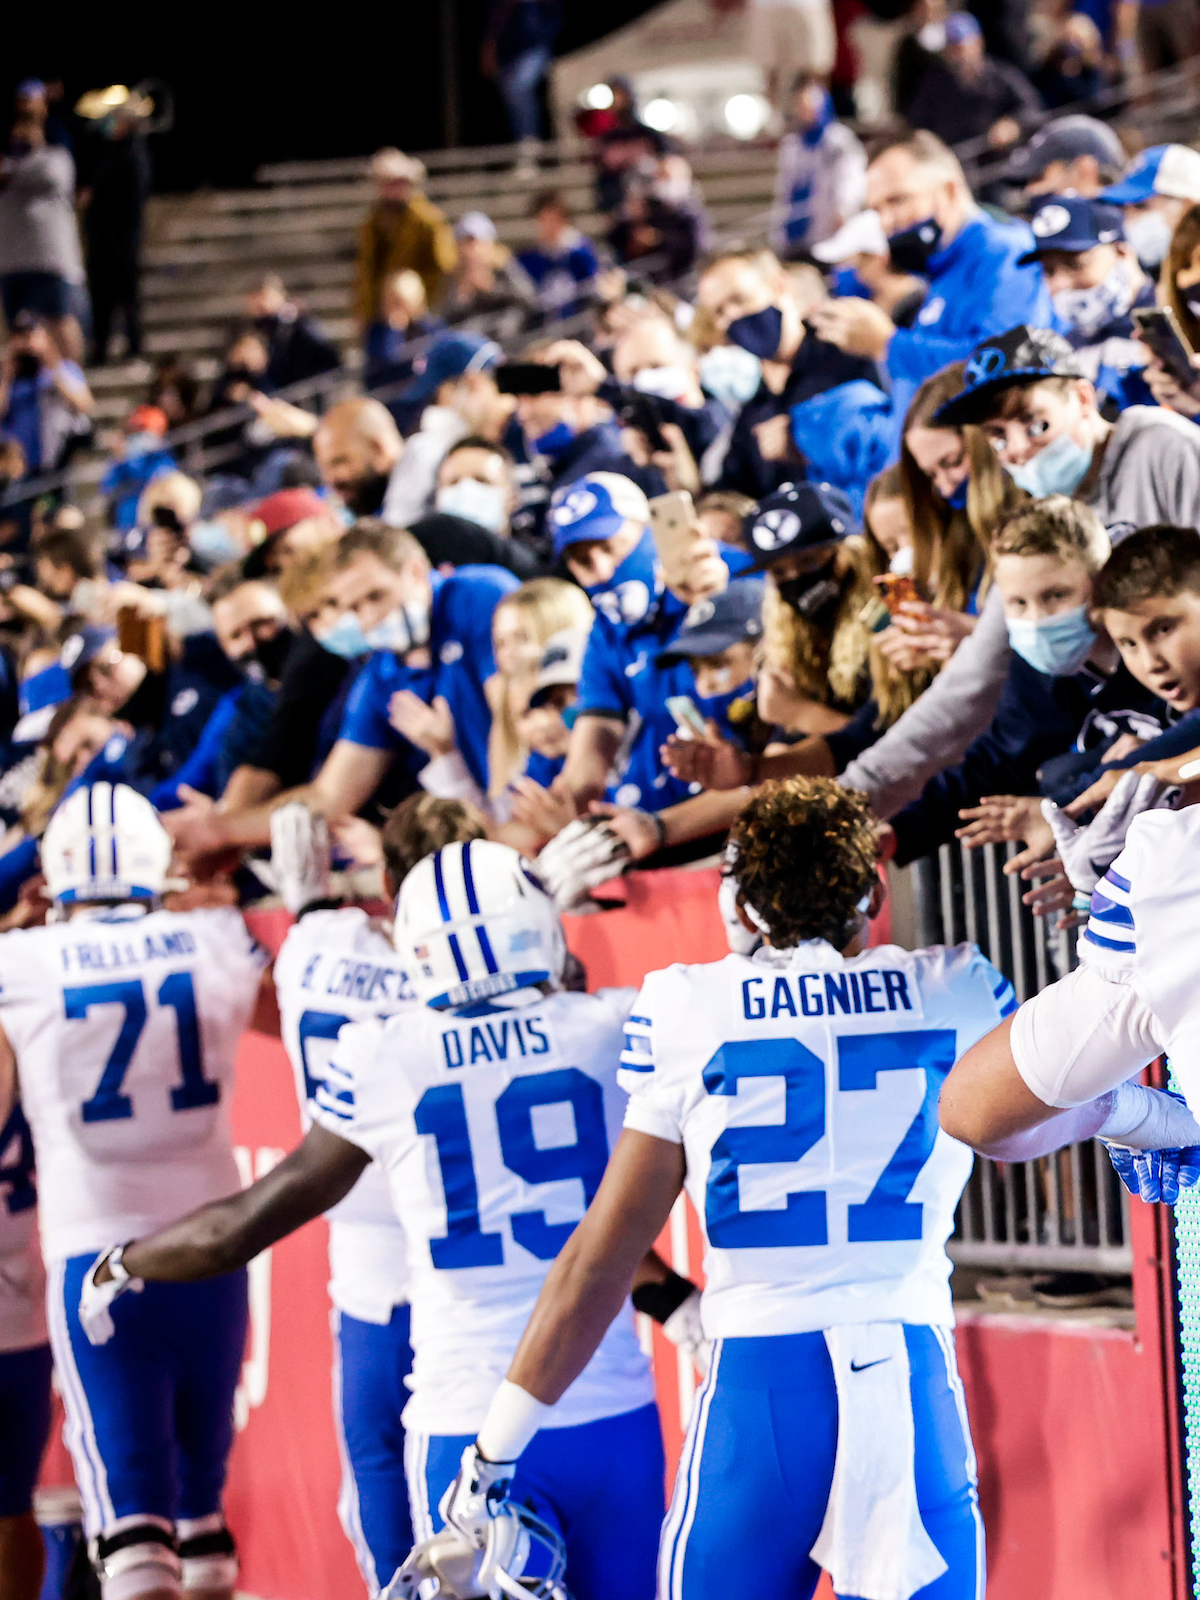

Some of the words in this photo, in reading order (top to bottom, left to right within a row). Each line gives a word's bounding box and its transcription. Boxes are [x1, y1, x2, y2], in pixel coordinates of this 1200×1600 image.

[63, 970, 220, 1123] 71
[442, 1017, 551, 1068] DAVIS
[743, 968, 913, 1020] GAGNIER
[414, 1066, 610, 1270] 19
[701, 1029, 957, 1249] 27
